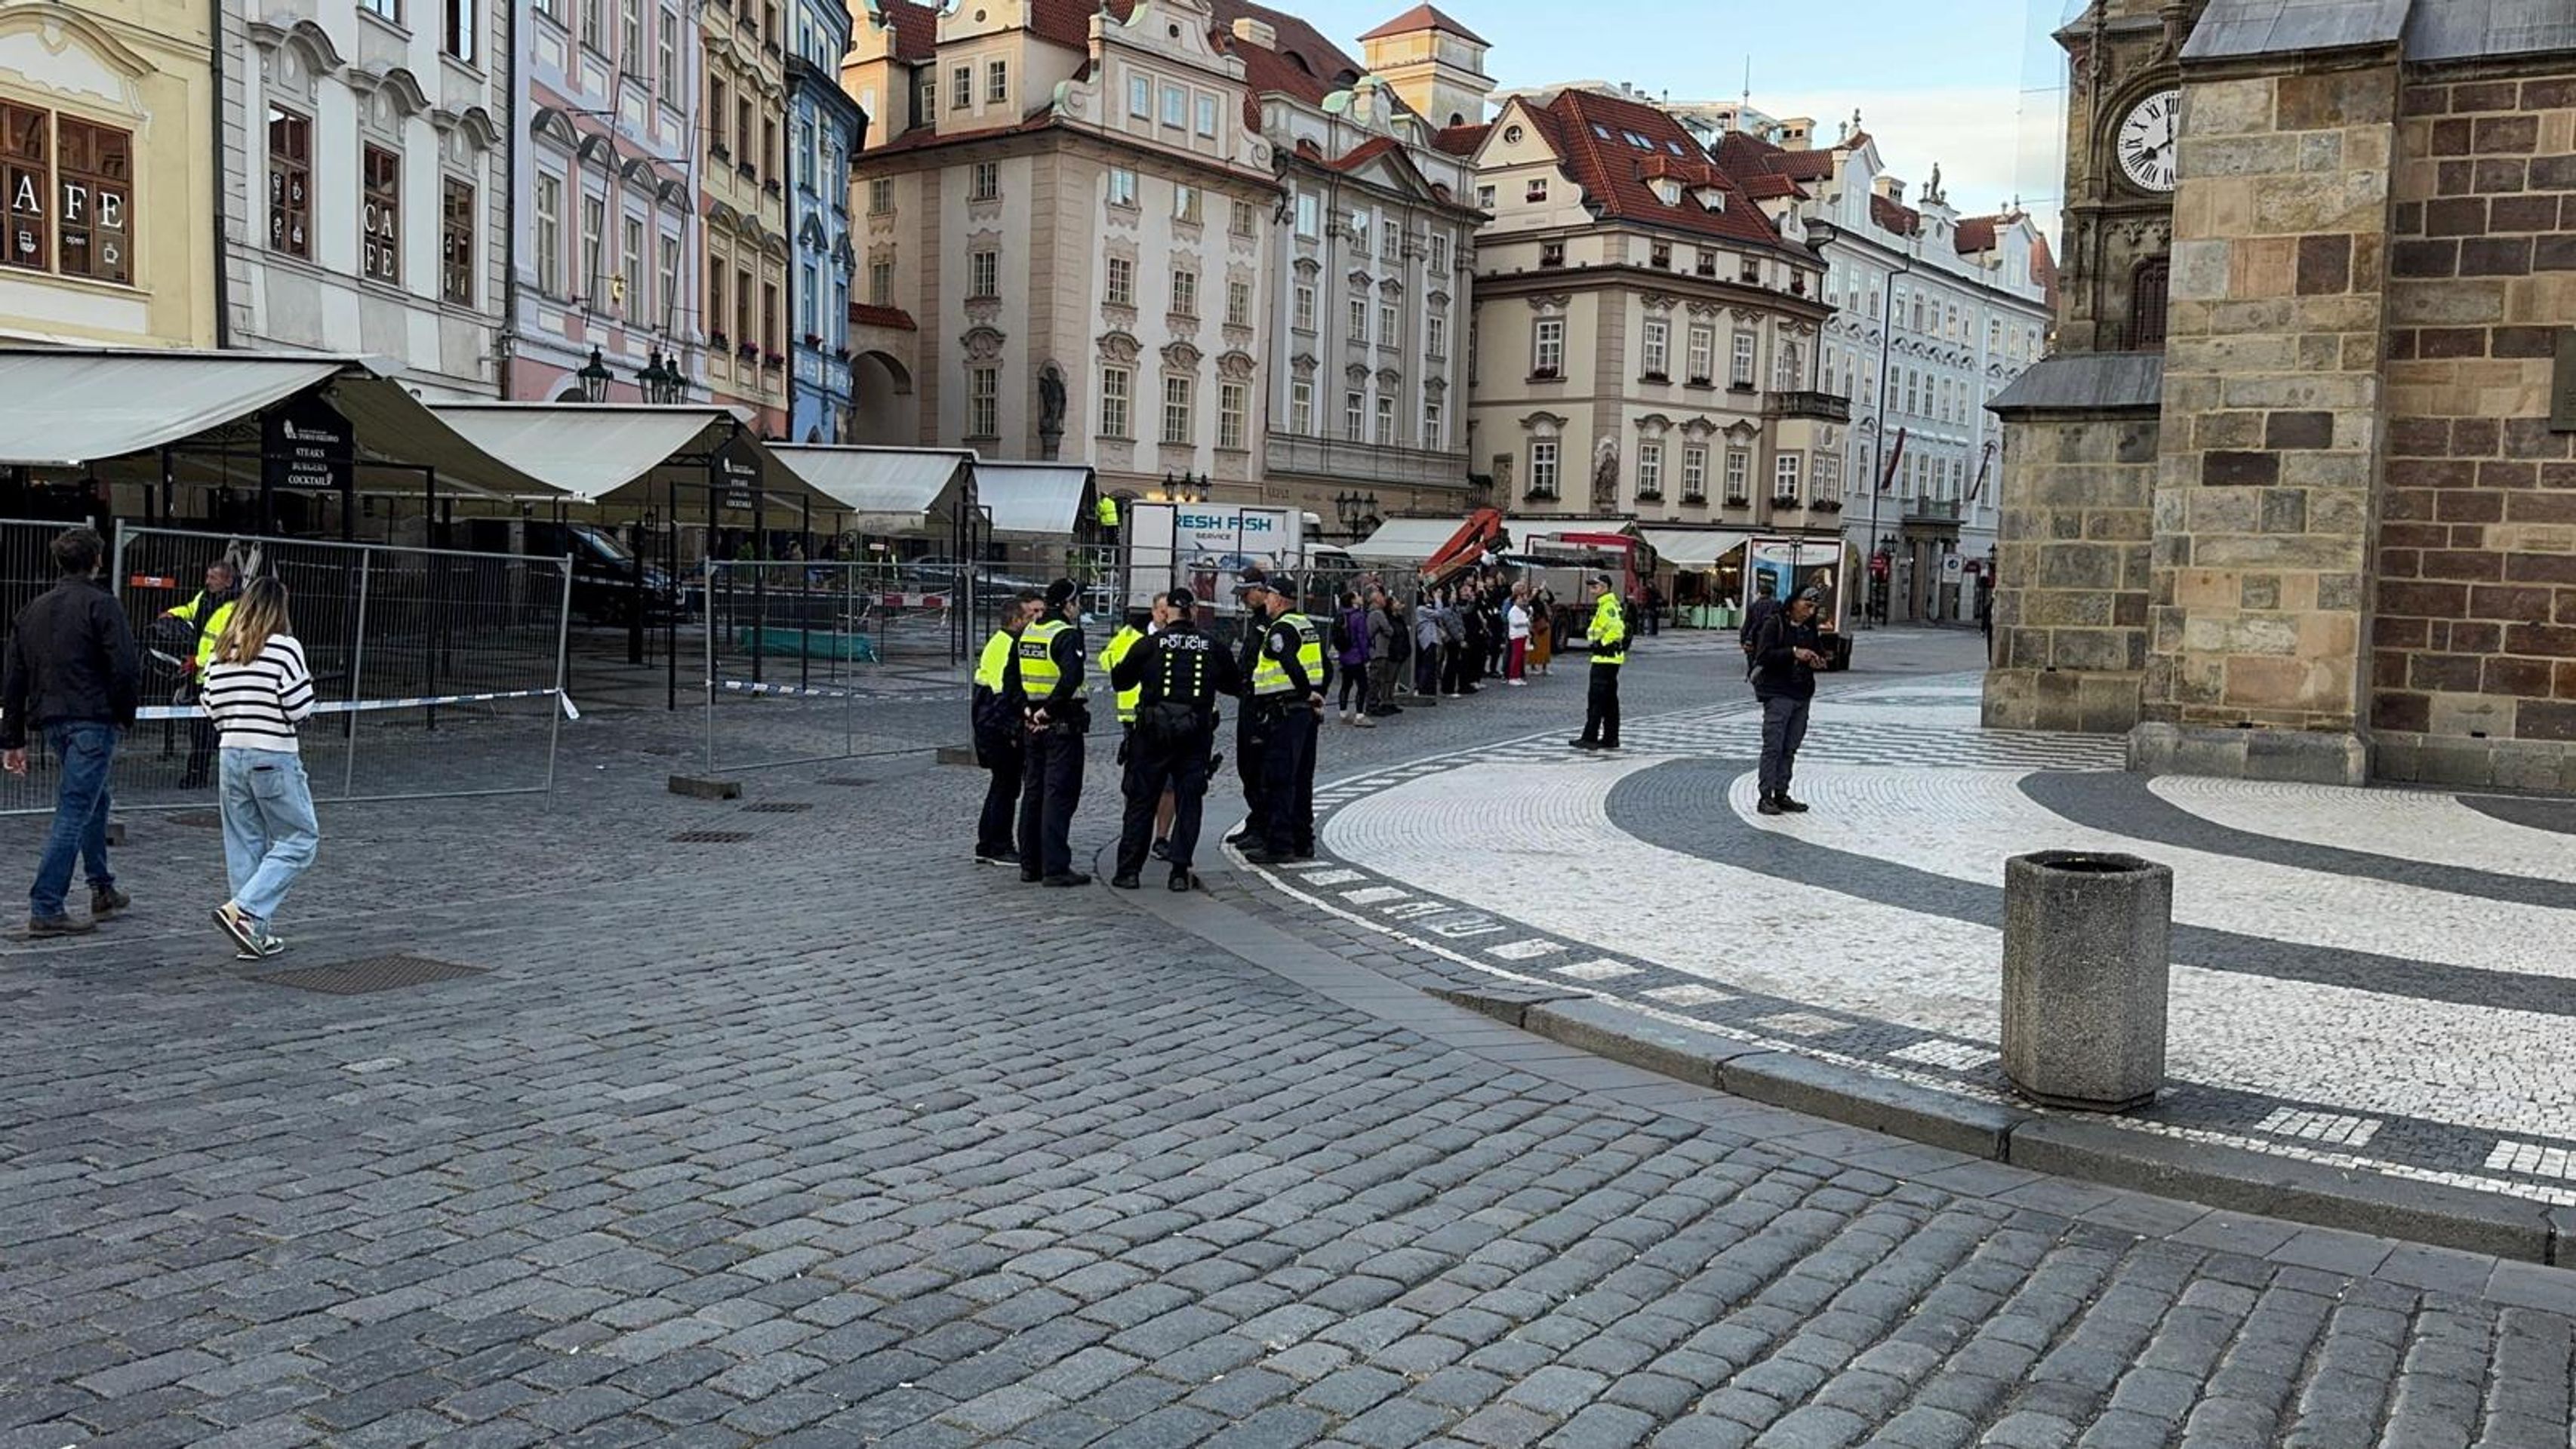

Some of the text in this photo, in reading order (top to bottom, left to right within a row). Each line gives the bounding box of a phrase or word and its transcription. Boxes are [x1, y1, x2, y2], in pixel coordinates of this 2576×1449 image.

[66, 235, 85, 245] open
[1227, 516, 1272, 531] FSH
[1196, 532, 1233, 540] SERVICE
